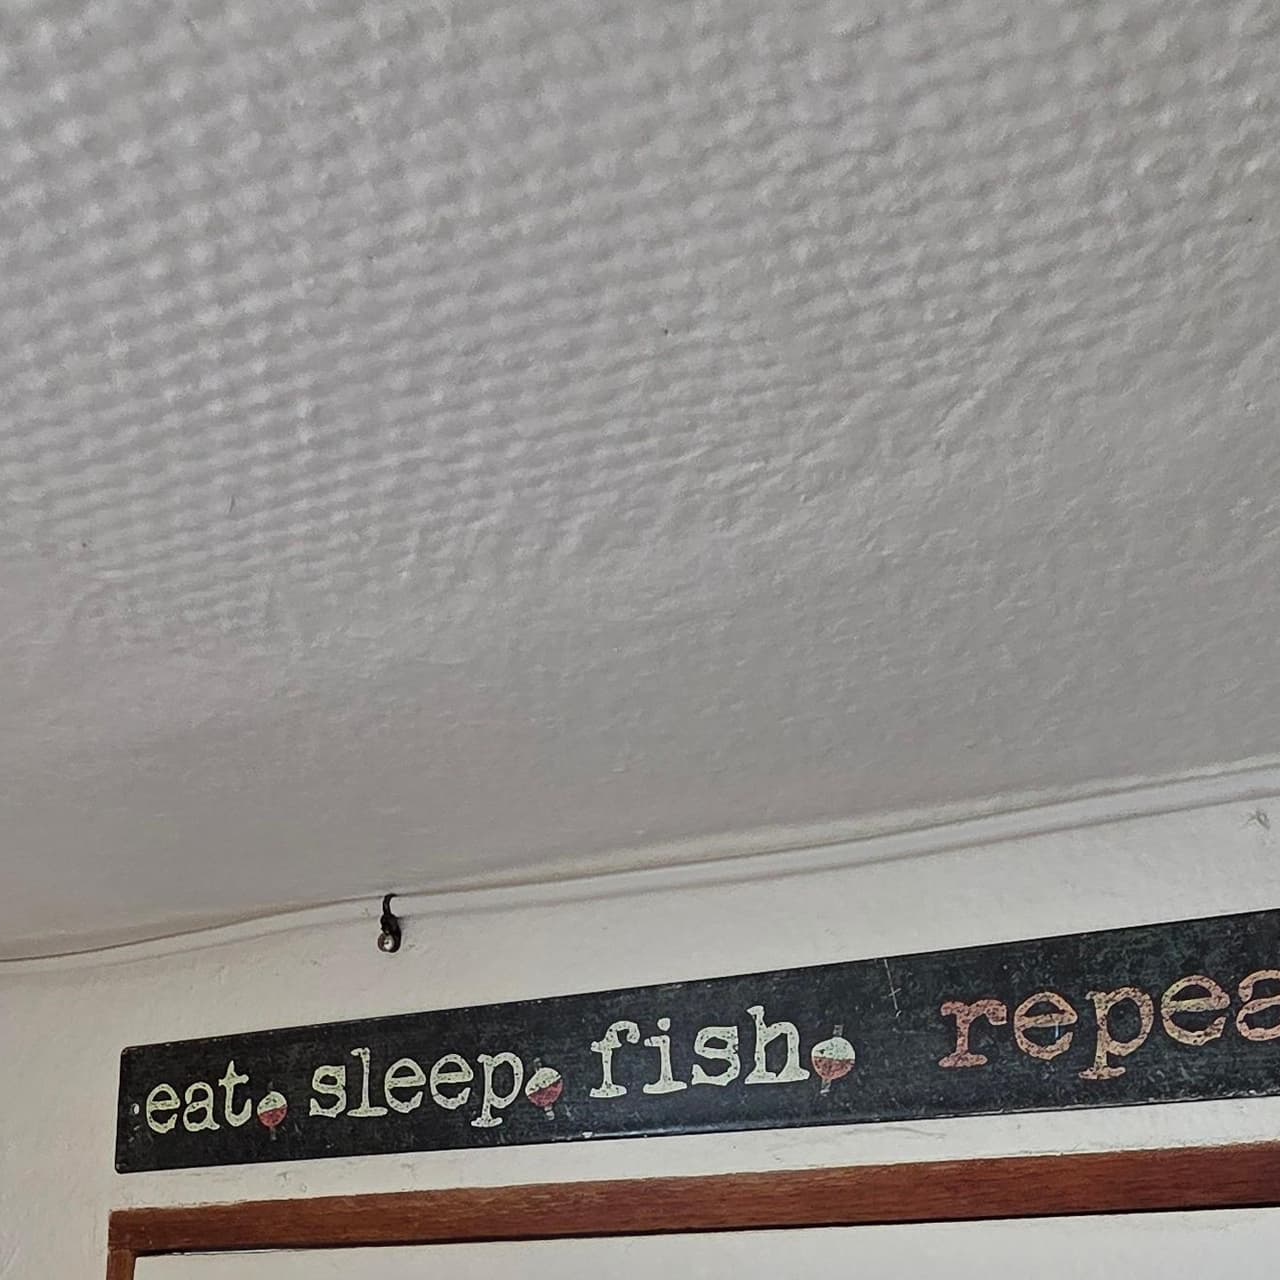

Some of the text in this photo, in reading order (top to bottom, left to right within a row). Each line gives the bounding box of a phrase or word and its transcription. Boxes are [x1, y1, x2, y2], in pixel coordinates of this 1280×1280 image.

[145, 1060, 253, 1134] eat
[308, 1047, 523, 1128] sleep
[589, 1005, 810, 1098] fish
